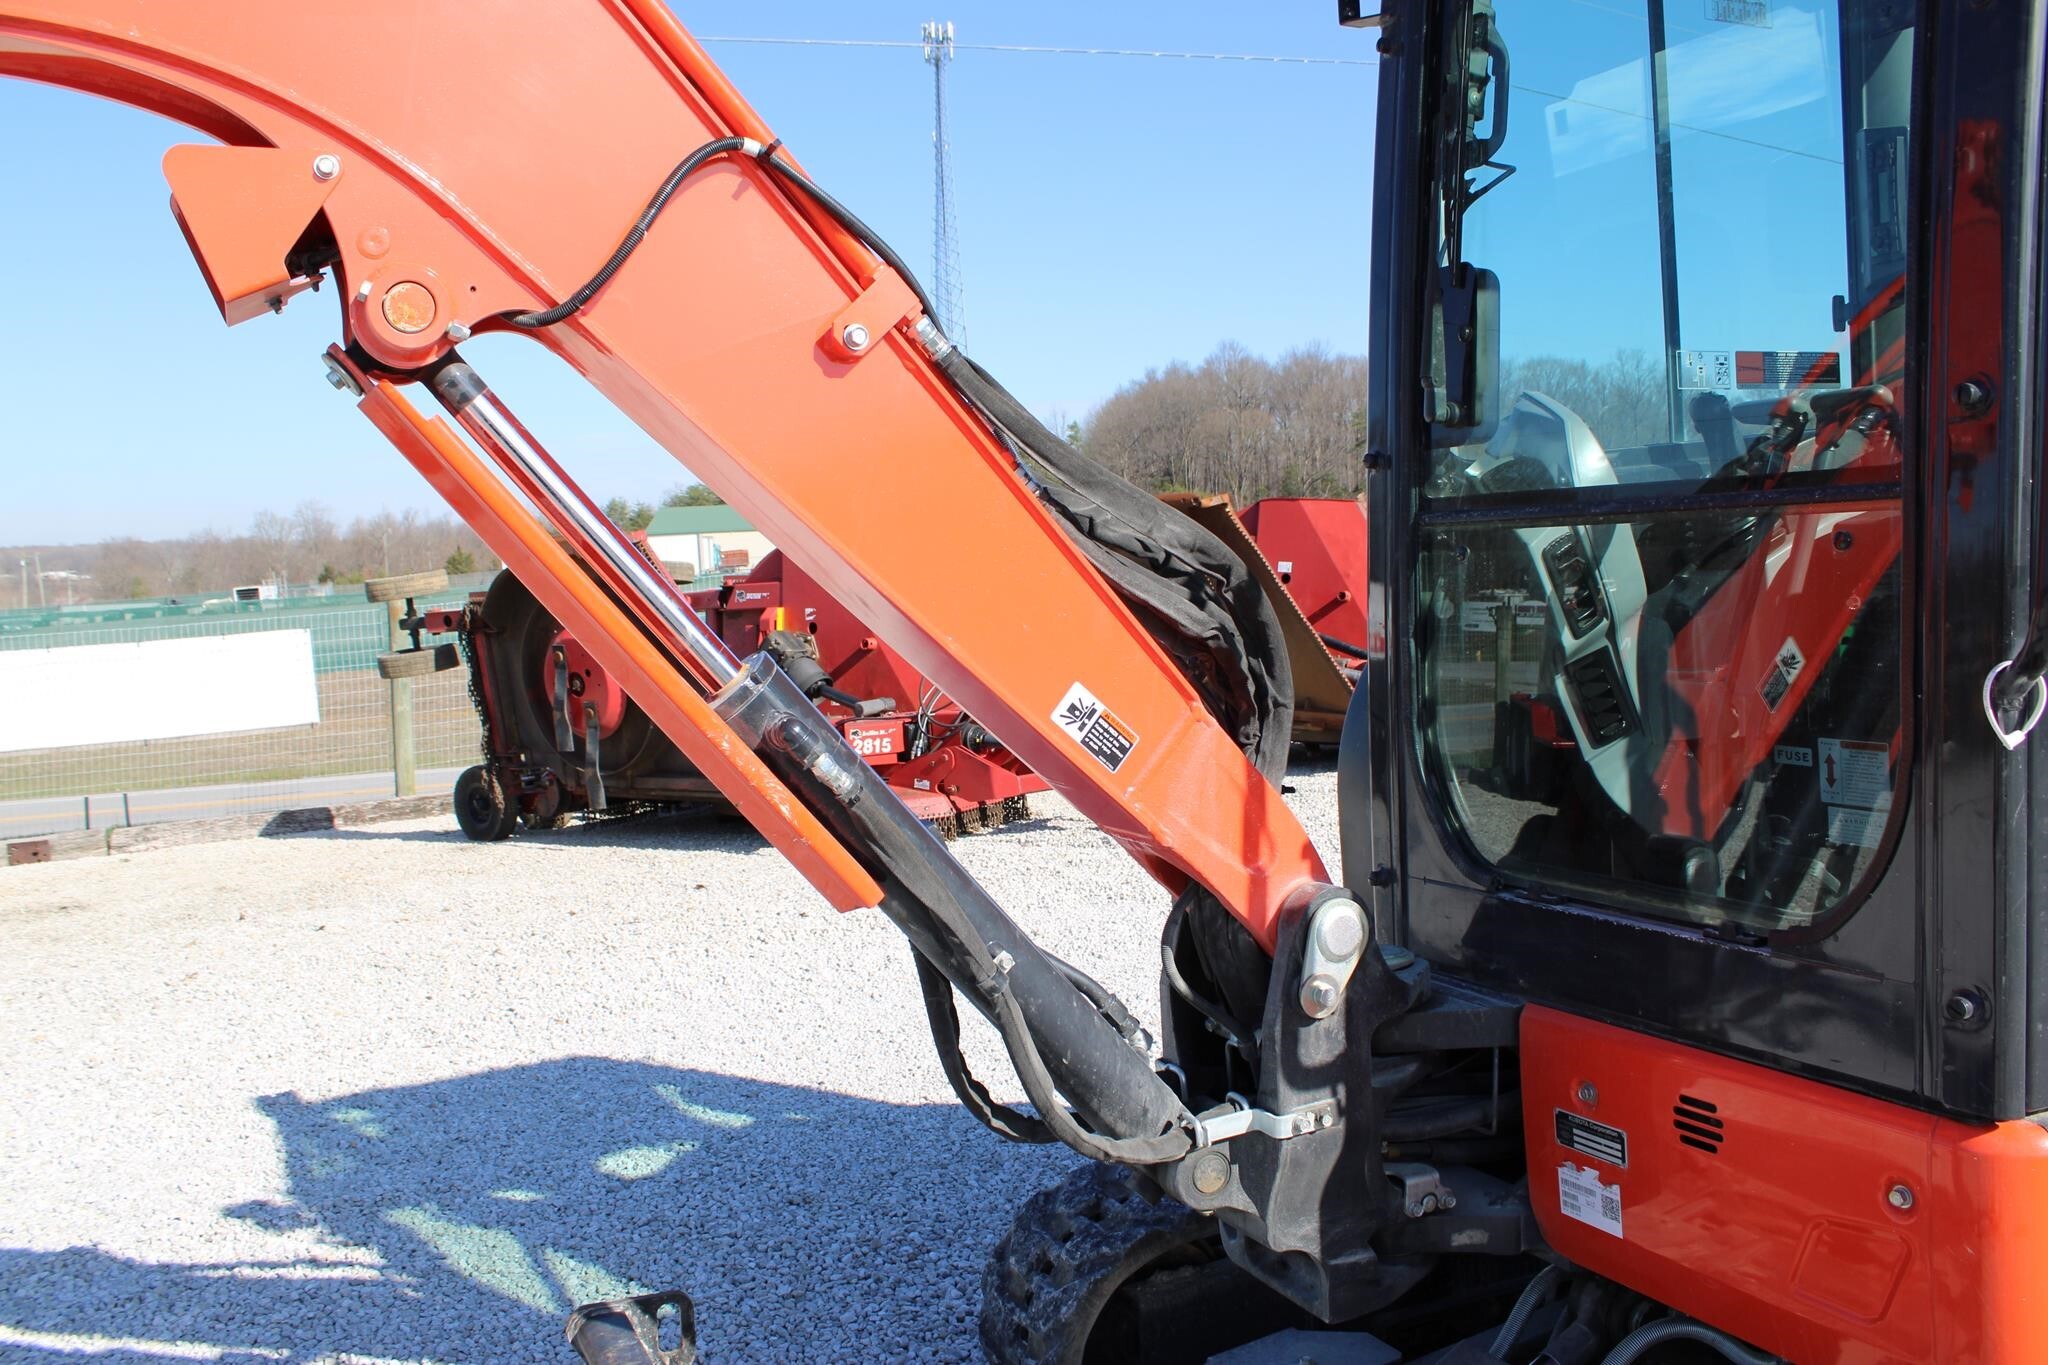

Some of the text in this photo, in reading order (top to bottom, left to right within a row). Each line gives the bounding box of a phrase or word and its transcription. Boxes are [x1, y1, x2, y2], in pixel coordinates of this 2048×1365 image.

[853, 737, 892, 755] 2815
[1777, 749, 1809, 762] FUSE
[1568, 1116, 1589, 1127] KUBOTA
[1589, 1123, 1619, 1137] Corporation
